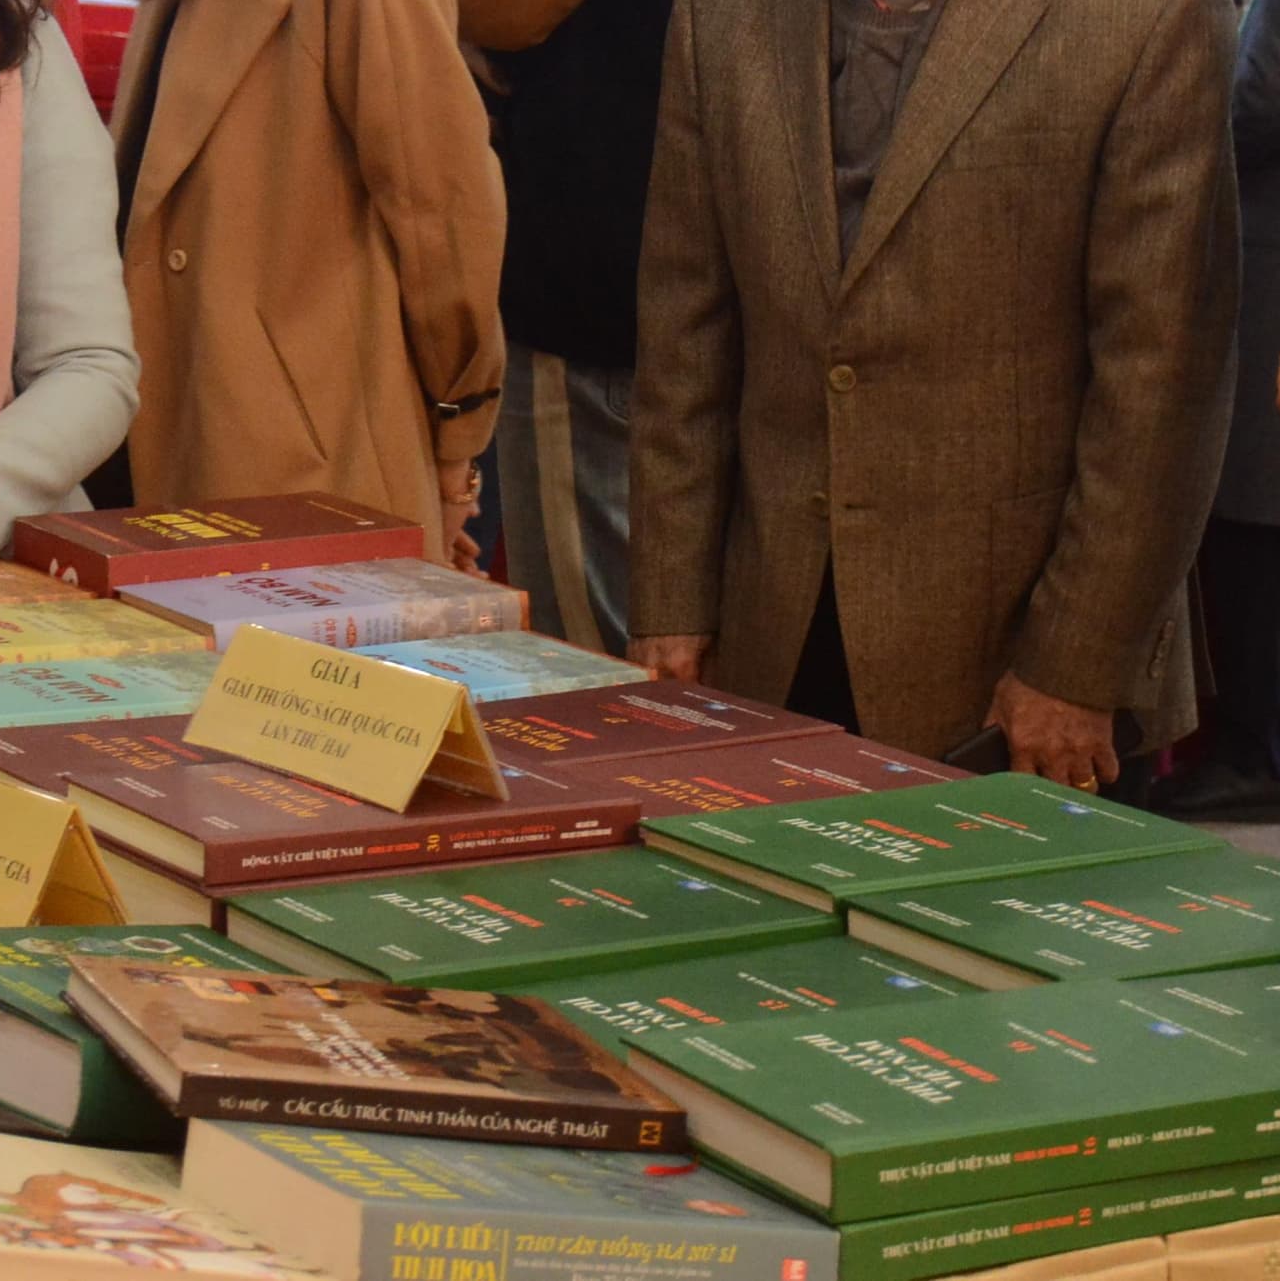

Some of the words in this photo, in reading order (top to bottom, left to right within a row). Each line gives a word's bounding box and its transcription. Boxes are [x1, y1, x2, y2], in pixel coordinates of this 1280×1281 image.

[351, 671, 363, 689] A
[322, 736, 351, 759] HAI
[394, 727, 421, 749] GIA
[340, 847, 363, 856] NAM
[426, 834, 441, 852] 30
[6, 860, 32, 885] GIA
[284, 1095, 316, 1115] CÁC
[319, 1096, 352, 1118] CẤU
[354, 1101, 392, 1122] TRÚC
[397, 1108, 433, 1126] TINH
[480, 1109, 512, 1131] CỦA
[514, 1115, 558, 1137] NGHỆ
[561, 1121, 609, 1141] THUẬT
